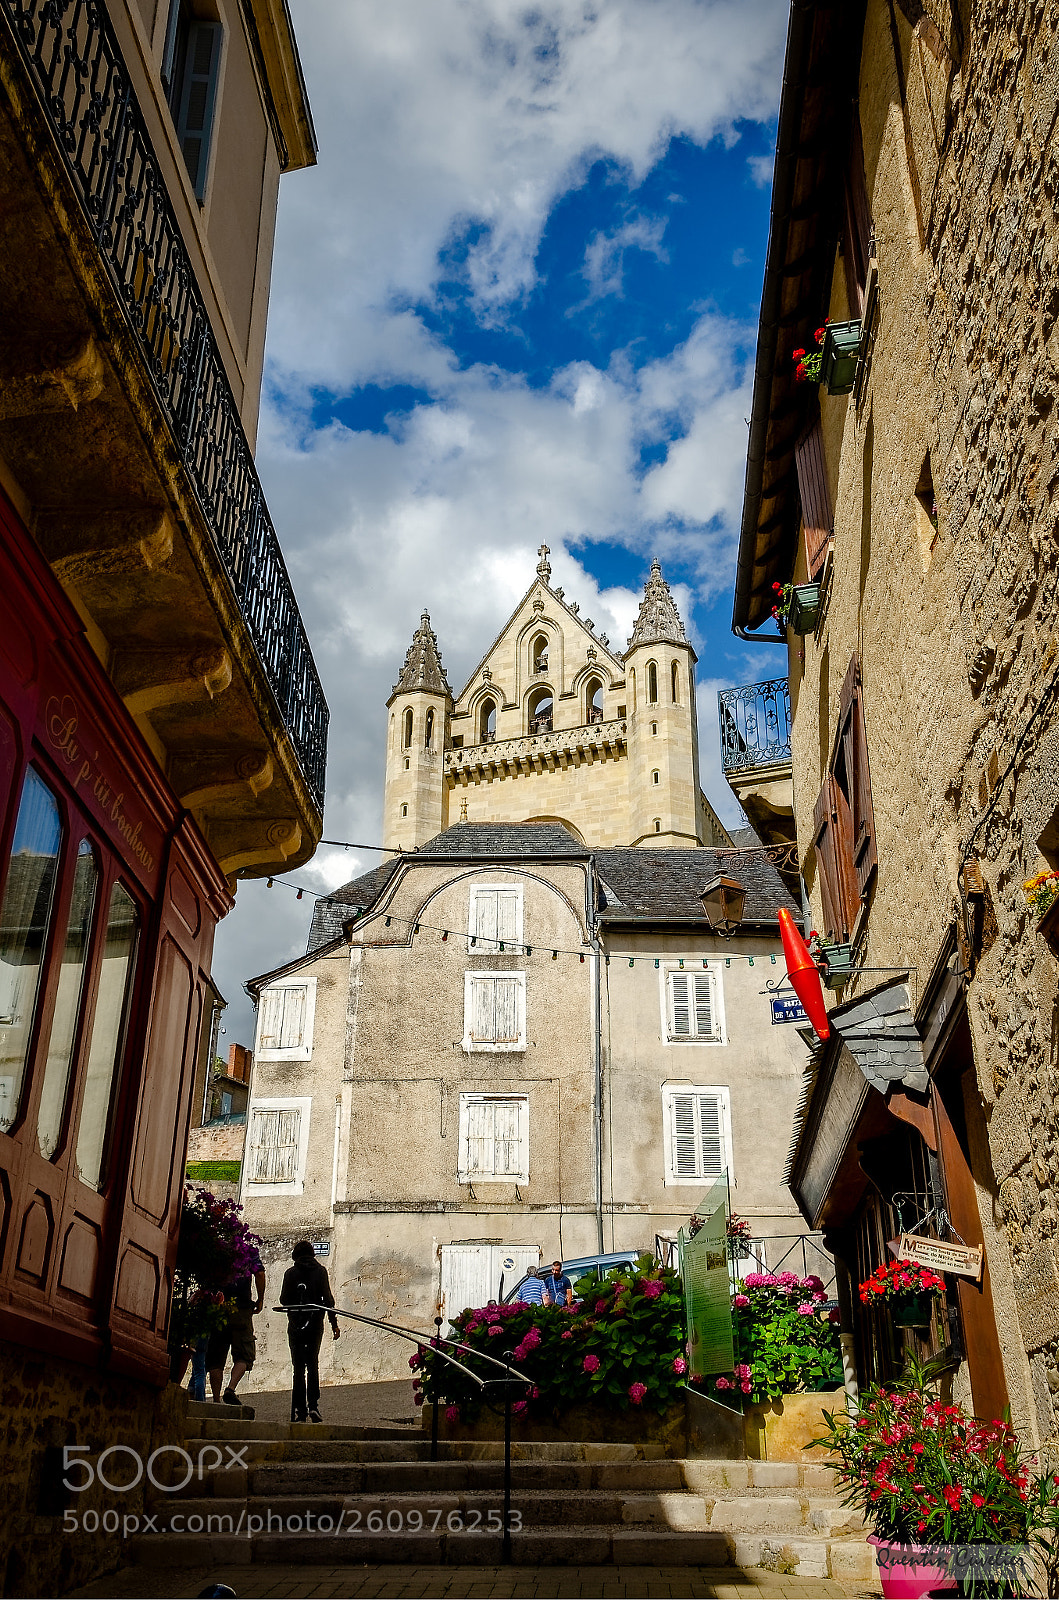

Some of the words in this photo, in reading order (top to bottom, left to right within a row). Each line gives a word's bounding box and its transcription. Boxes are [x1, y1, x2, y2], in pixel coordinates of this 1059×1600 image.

[72, 750, 112, 808] p'tit
[111, 793, 155, 873] bonheur
[775, 1011, 784, 1019] DE
[785, 1010, 795, 1018] LA
